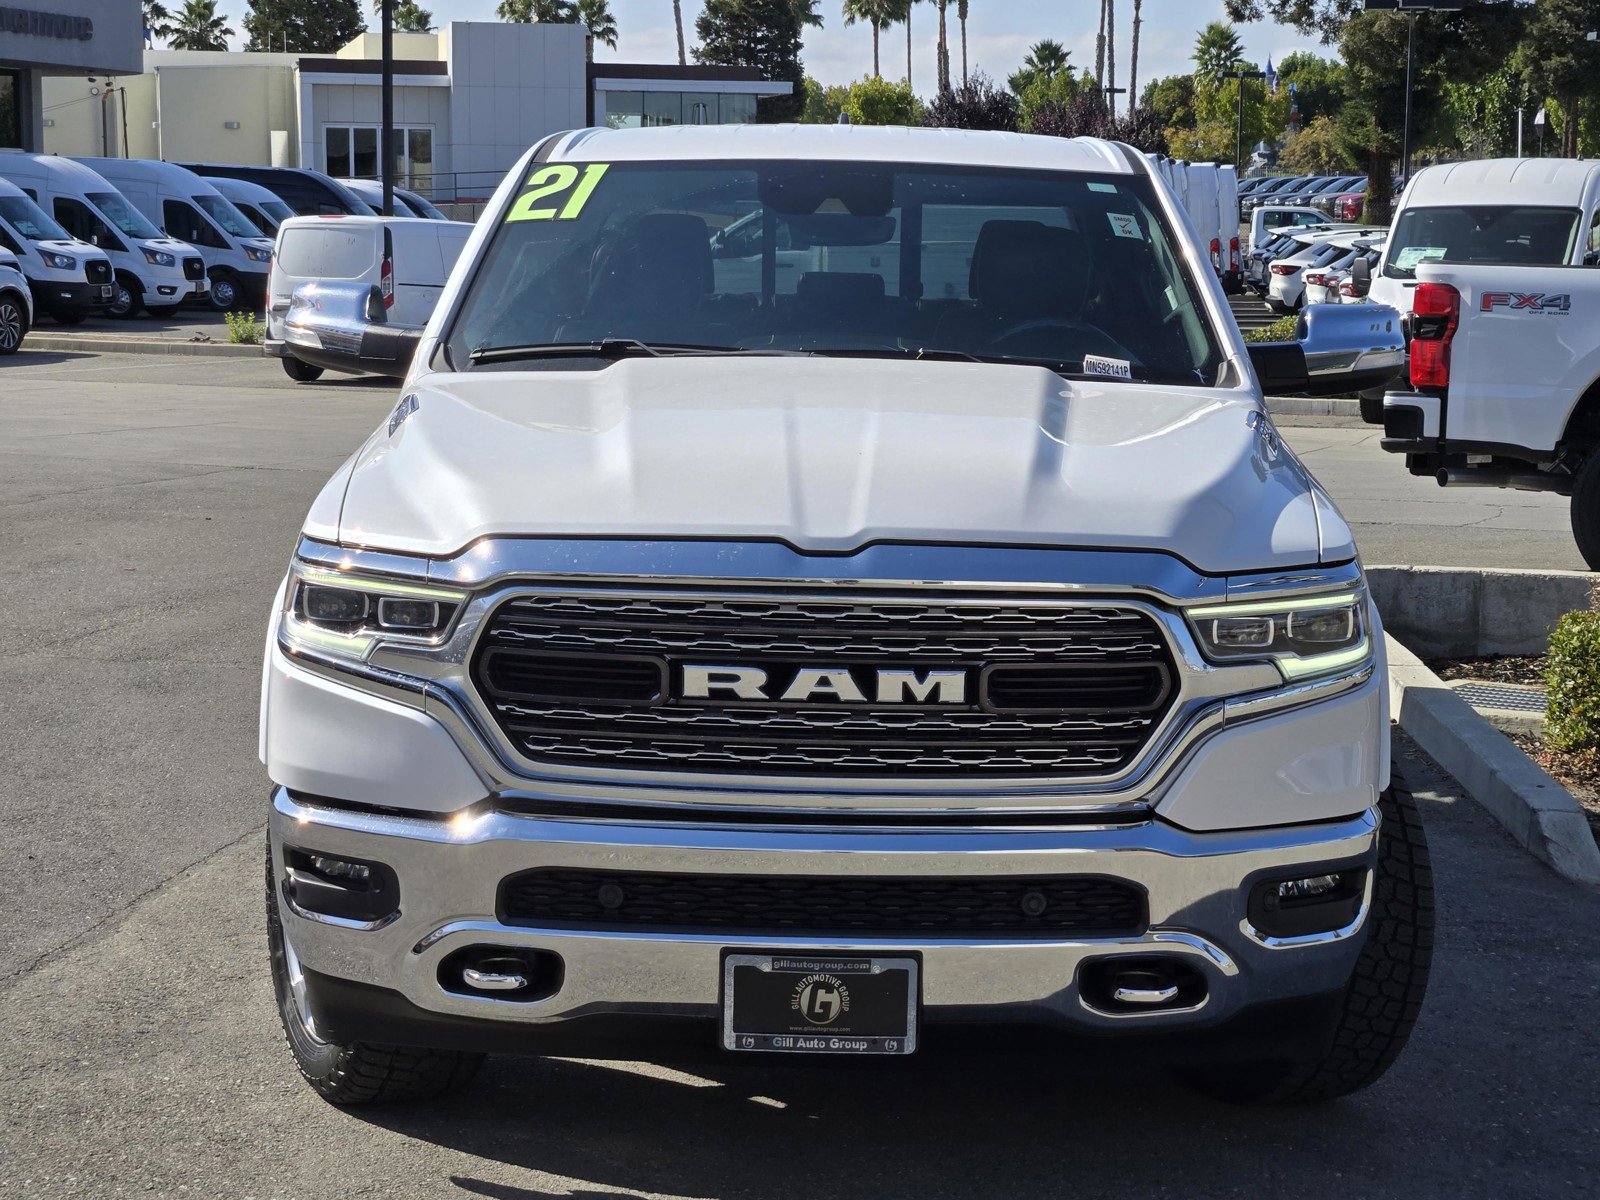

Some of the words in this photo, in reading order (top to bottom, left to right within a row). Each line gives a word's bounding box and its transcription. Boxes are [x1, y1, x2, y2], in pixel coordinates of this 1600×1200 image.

[505, 164, 610, 223] 21
[1480, 291, 1571, 312] FX4
[1085, 359, 1129, 377] MN592141P
[683, 665, 967, 703] RAM
[773, 959, 870, 973] gillautogroup.com
[791, 993, 801, 1010] GILL
[797, 974, 841, 993] AUTOMOTIVE
[839, 983, 851, 1012] GROUP
[773, 1037, 794, 1048] Gill
[797, 1038, 826, 1049] Auto
[829, 1038, 868, 1051] Group
